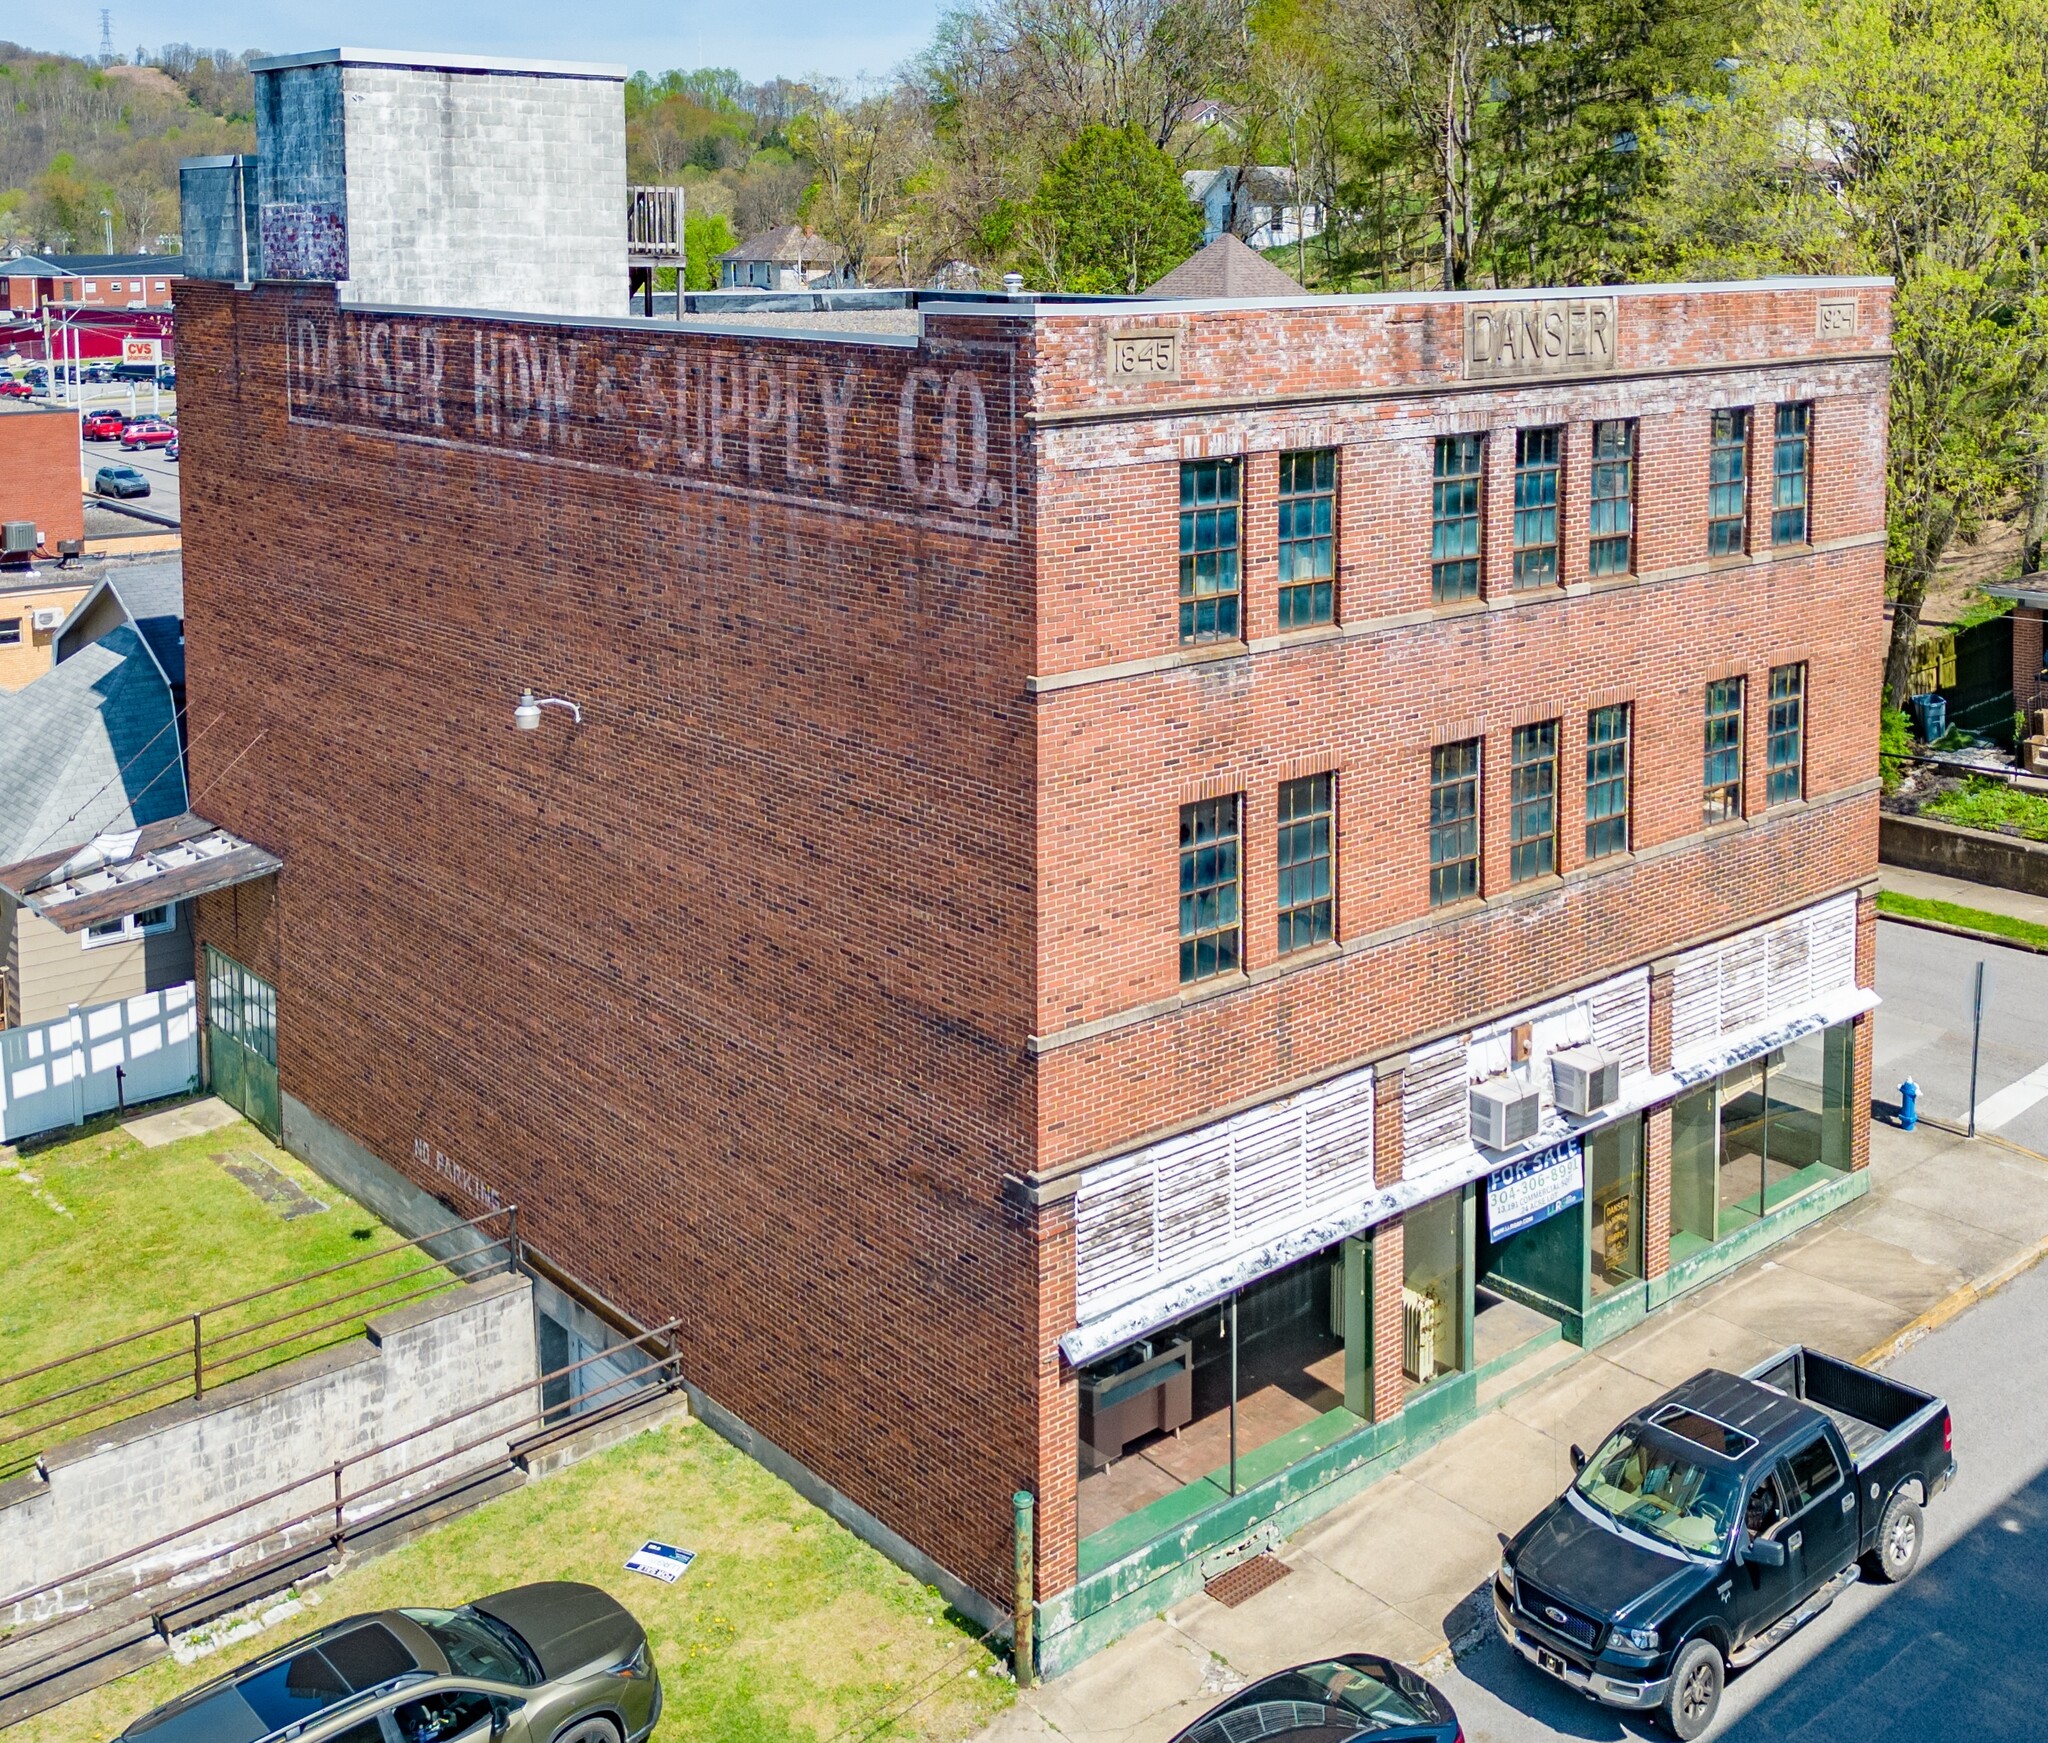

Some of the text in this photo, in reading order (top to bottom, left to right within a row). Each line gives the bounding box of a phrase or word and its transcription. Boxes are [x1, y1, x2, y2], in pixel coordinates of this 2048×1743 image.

[128, 343, 152, 355] CVS
[1115, 342, 1171, 373] 1845
[1472, 306, 1608, 362] DANSER
[297, 317, 445, 427] DANSER
[899, 366, 1003, 508] CO.
[414, 1138, 501, 1212] NO PARKING
[1490, 1157, 1579, 1207] 304-306-8991
[1491, 1137, 1578, 1191] FOR SALE
[1519, 1183, 1561, 1206] COMMERCIAL
